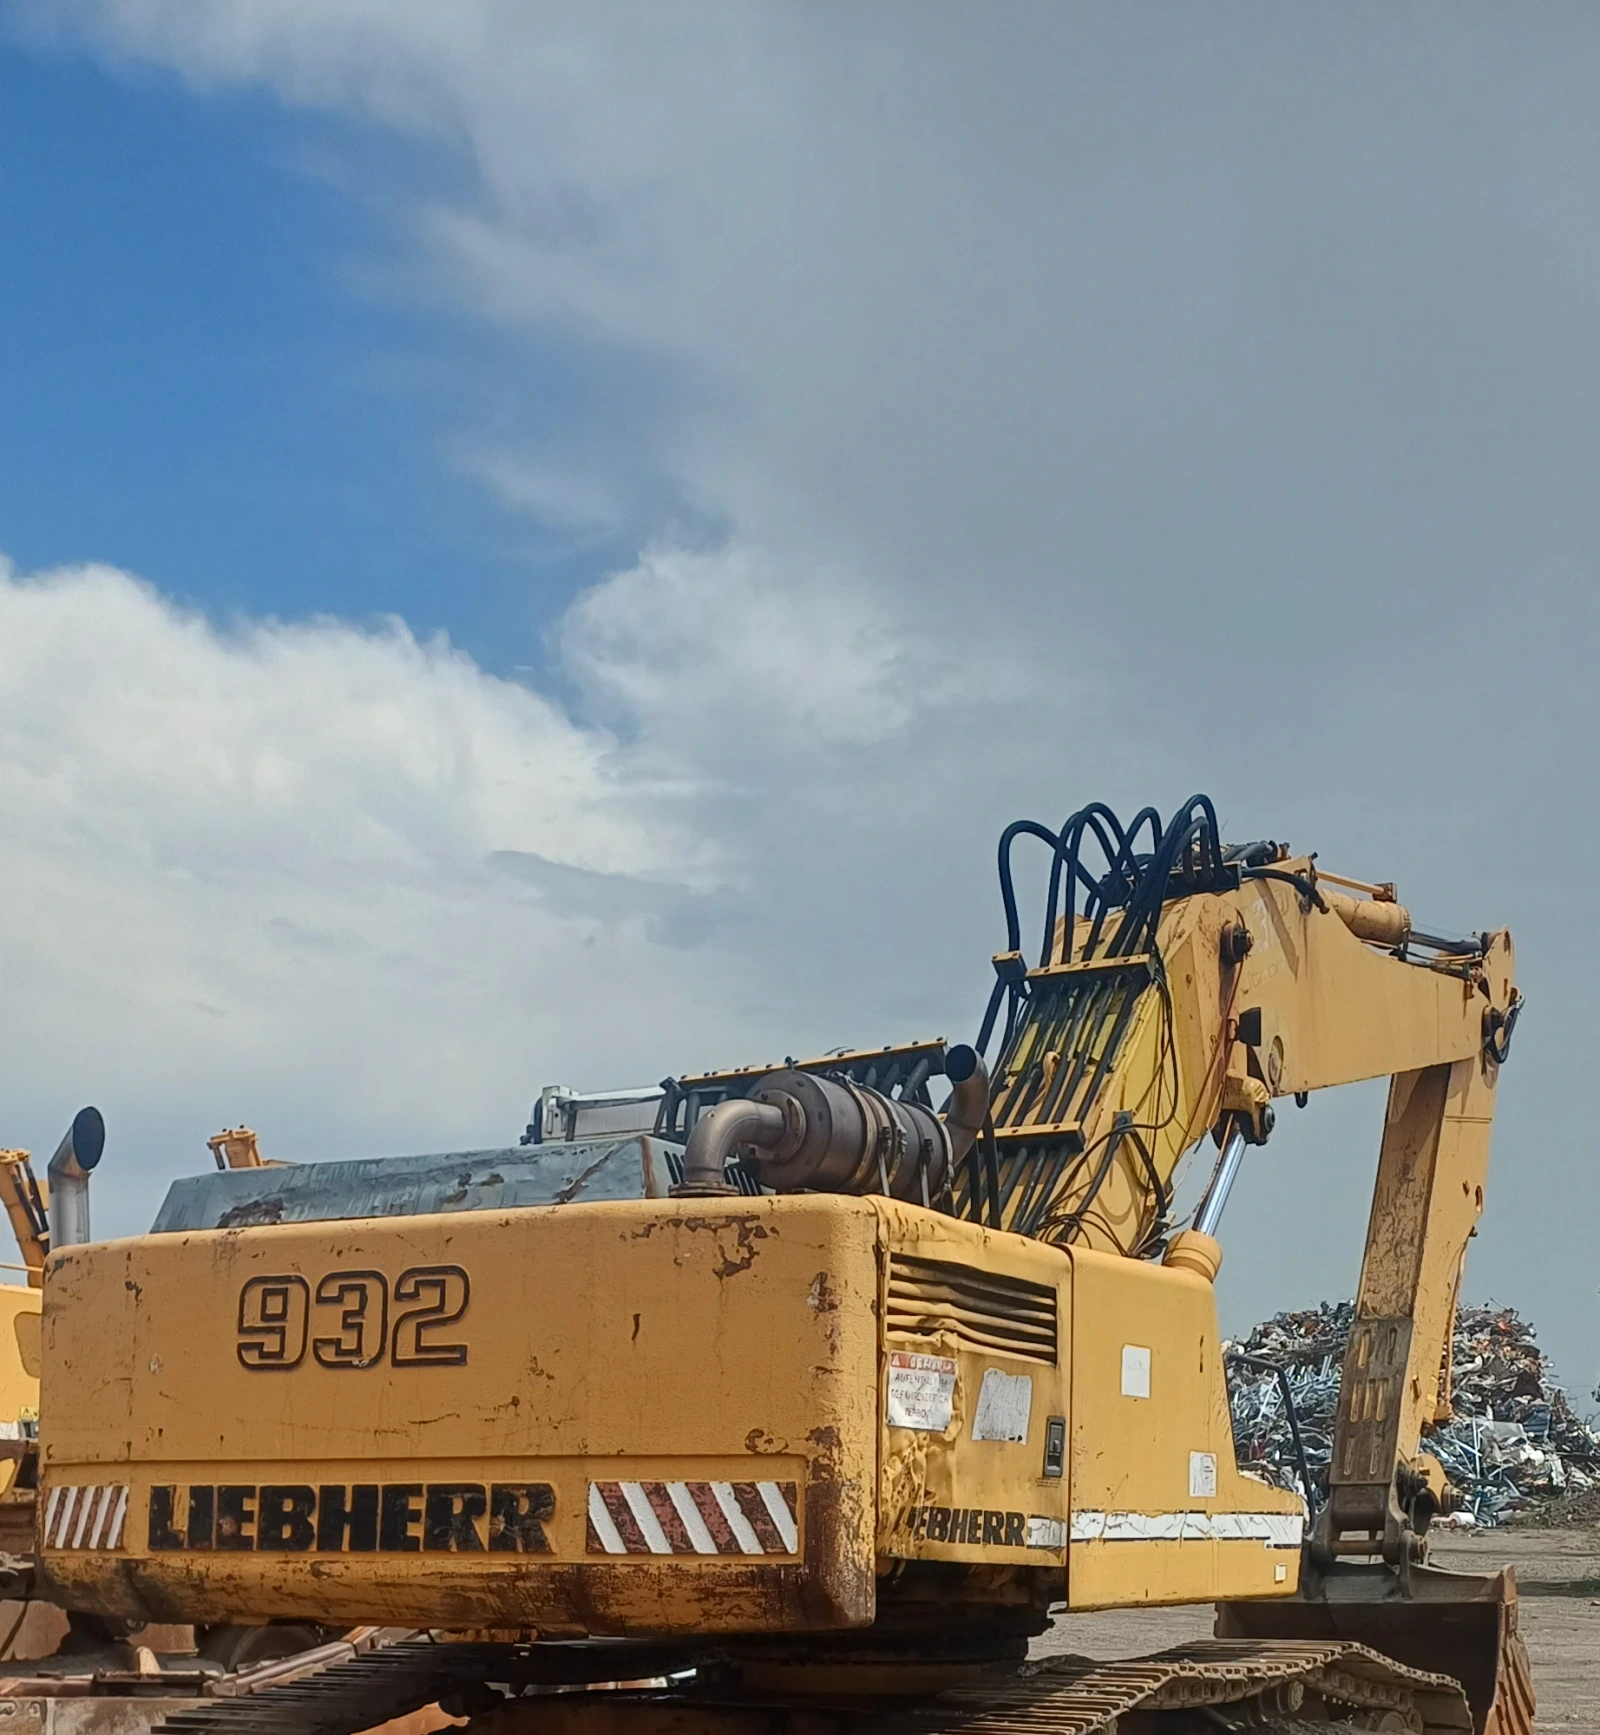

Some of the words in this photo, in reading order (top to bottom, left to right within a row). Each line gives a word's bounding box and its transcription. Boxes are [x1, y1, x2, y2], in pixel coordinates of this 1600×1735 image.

[237, 1265, 470, 1370] 932
[147, 1483, 556, 1554] LIEBHERR
[893, 1506, 1026, 1547] IEBHERR
